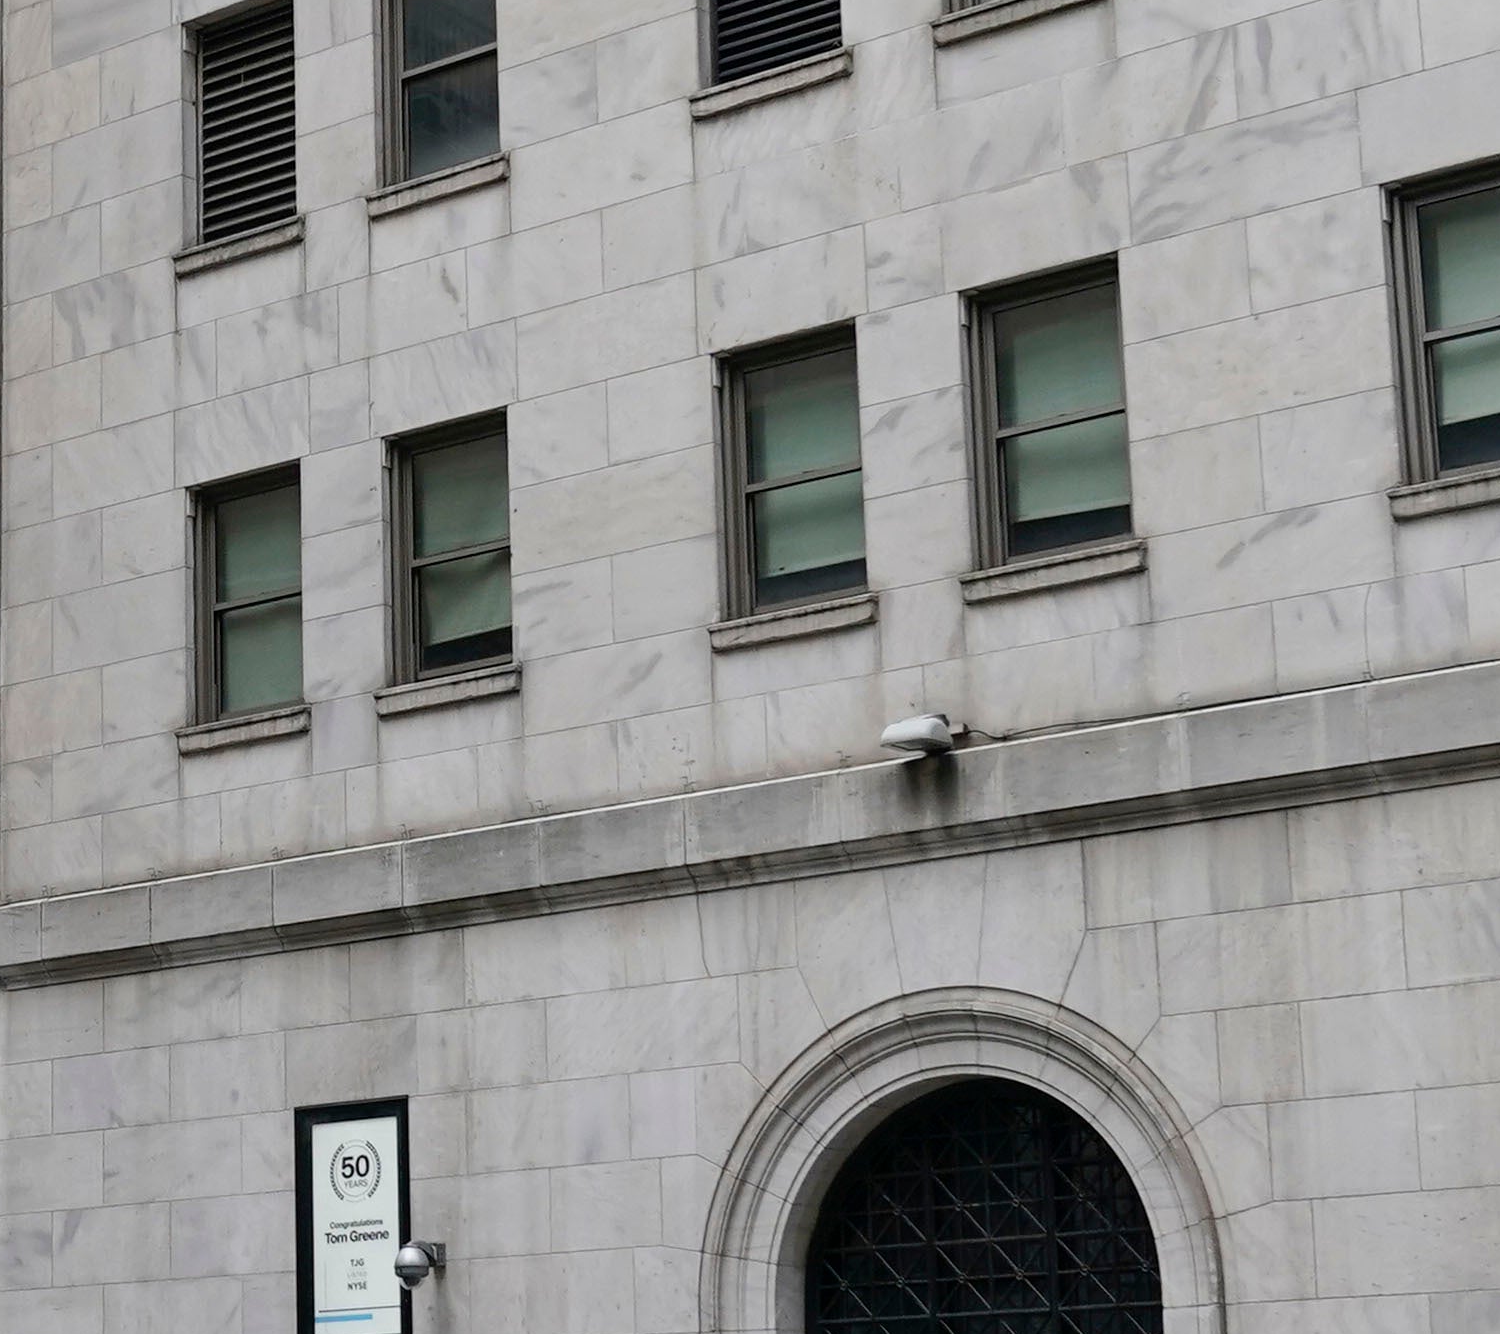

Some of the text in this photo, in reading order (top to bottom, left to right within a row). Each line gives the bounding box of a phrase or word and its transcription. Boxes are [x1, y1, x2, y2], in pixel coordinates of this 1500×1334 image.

[341, 1154, 370, 1179] 50
[343, 1179, 368, 1189] YEARS
[329, 1218, 384, 1231] Congratulations
[324, 1229, 390, 1244] Tom Greene
[347, 1280, 368, 1291] NYSE
